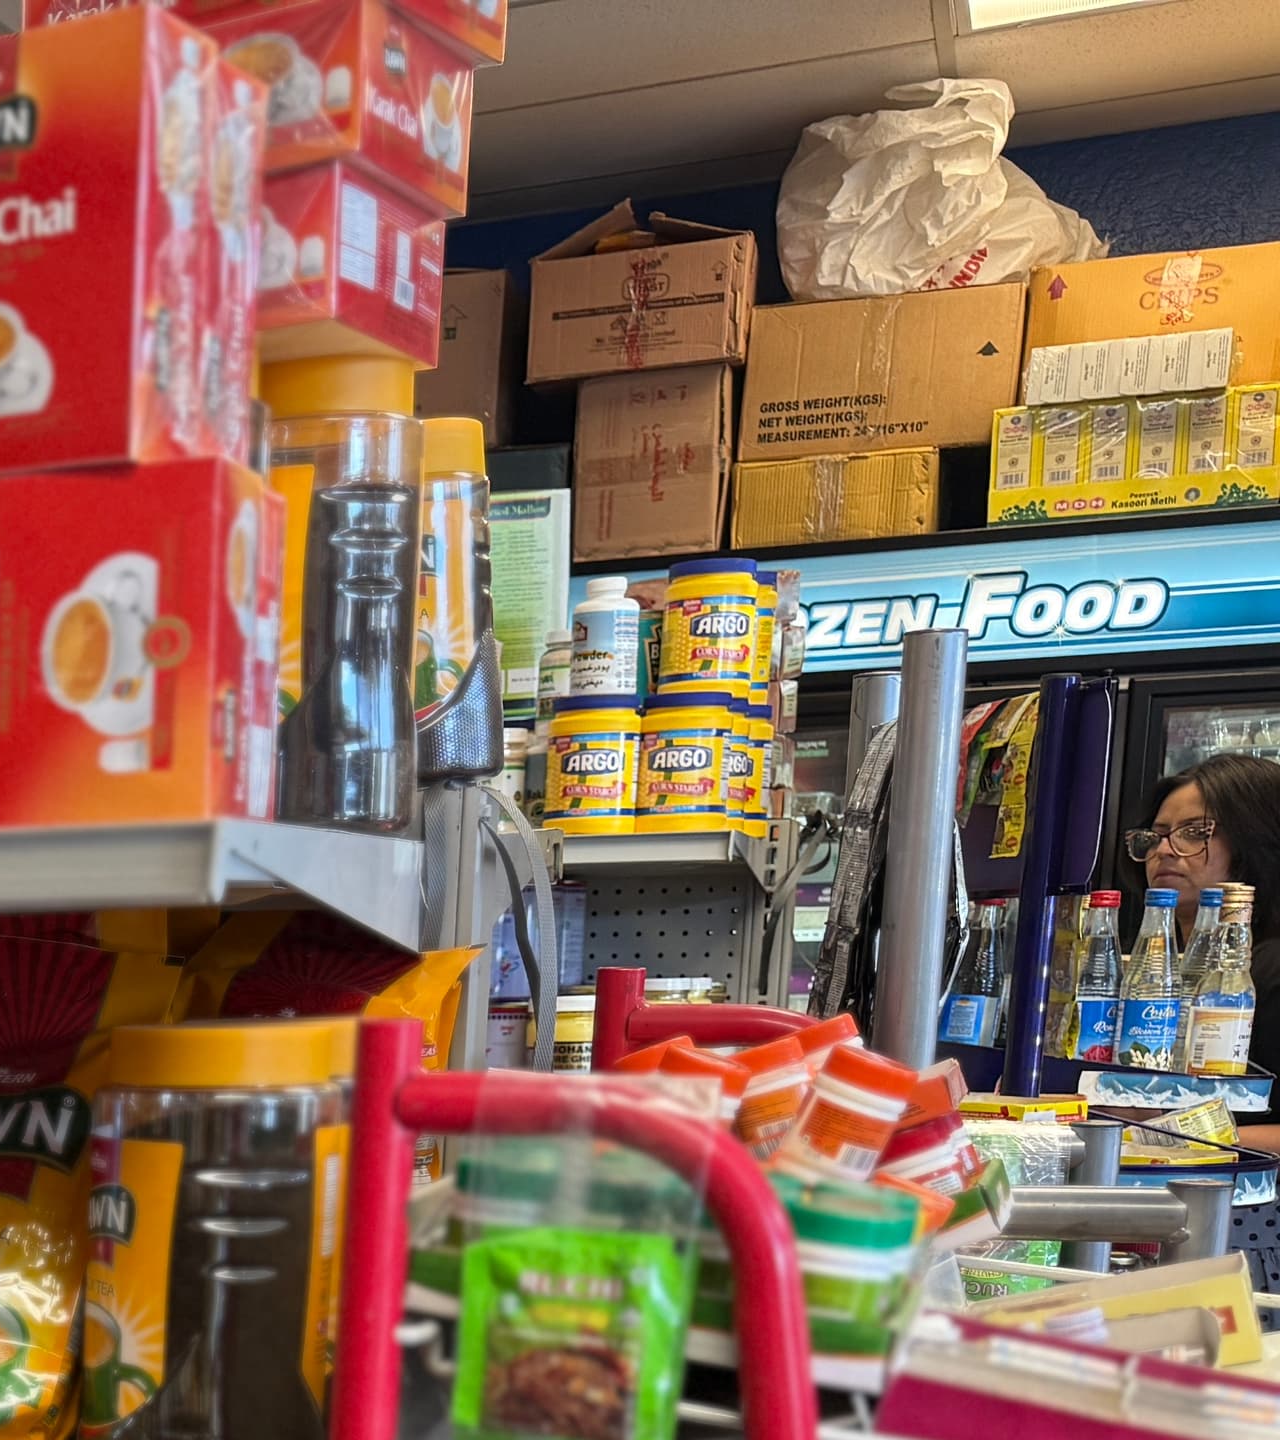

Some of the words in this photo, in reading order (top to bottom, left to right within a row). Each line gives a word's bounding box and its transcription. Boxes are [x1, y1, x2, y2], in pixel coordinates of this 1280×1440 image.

[759, 398, 803, 413] GROSS
[805, 394, 888, 412] WEIGHT(KGS):
[757, 414, 782, 428] NET
[756, 427, 851, 444] MEASUREMENT:
[1111, 497, 1148, 510] Kasoori
[1150, 493, 1178, 507] Methi
[696, 615, 748, 635] ARGO
[566, 753, 619, 773] ARGO
[652, 748, 707, 769] ARGO
